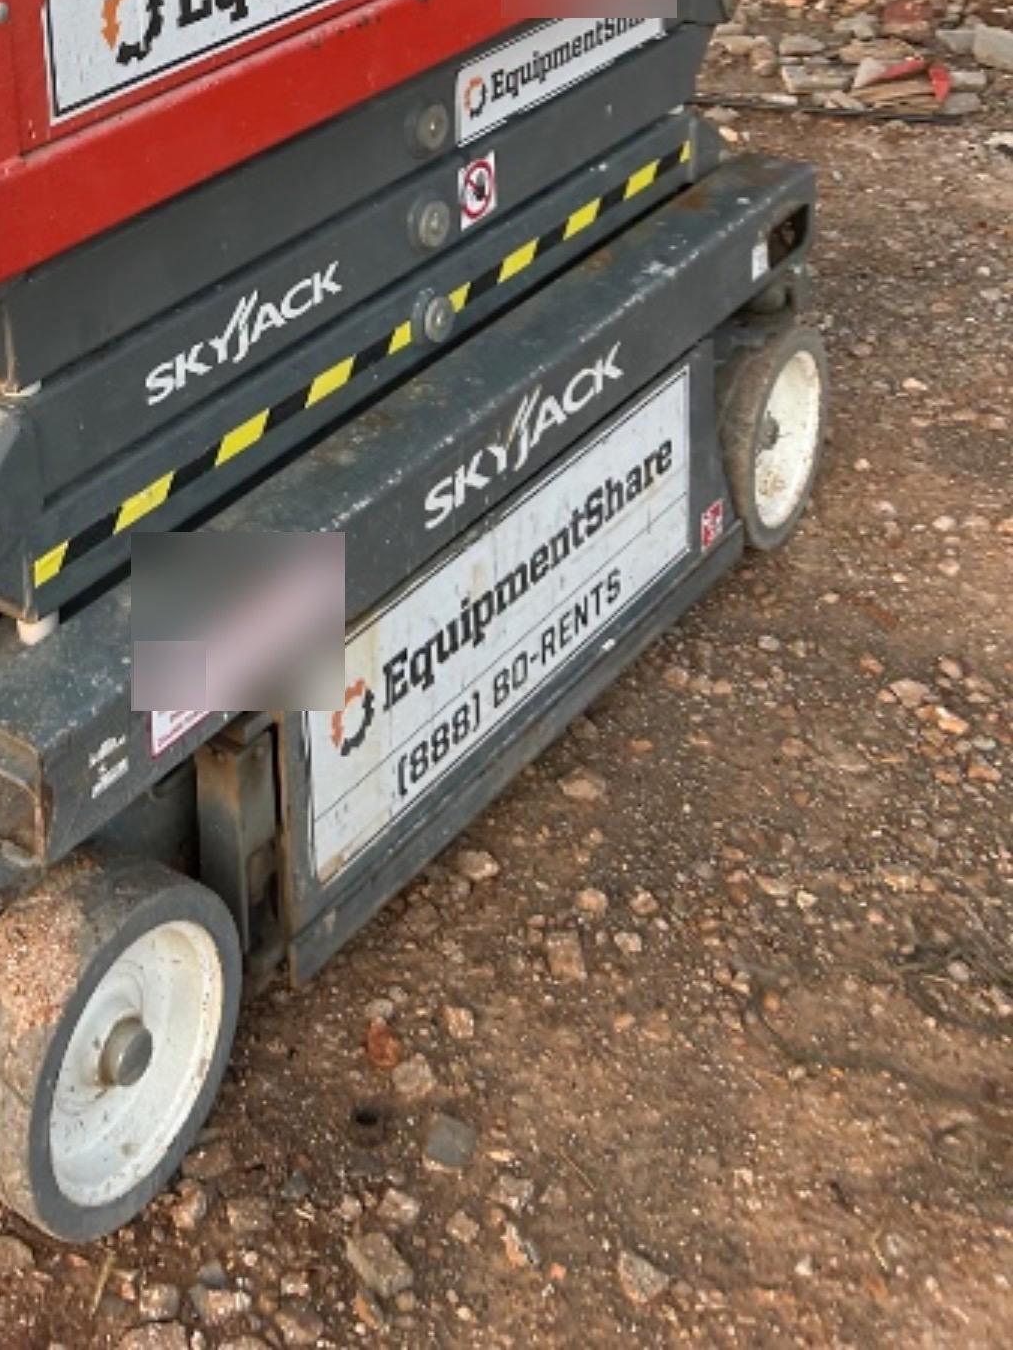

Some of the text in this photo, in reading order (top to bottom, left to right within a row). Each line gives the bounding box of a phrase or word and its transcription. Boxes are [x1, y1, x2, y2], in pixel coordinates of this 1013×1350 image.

[145, 260, 342, 406] SKYJACK
[424, 340, 624, 530] SKYJACK
[382, 438, 673, 712] EquipmentShare
[397, 689, 481, 796] (888)
